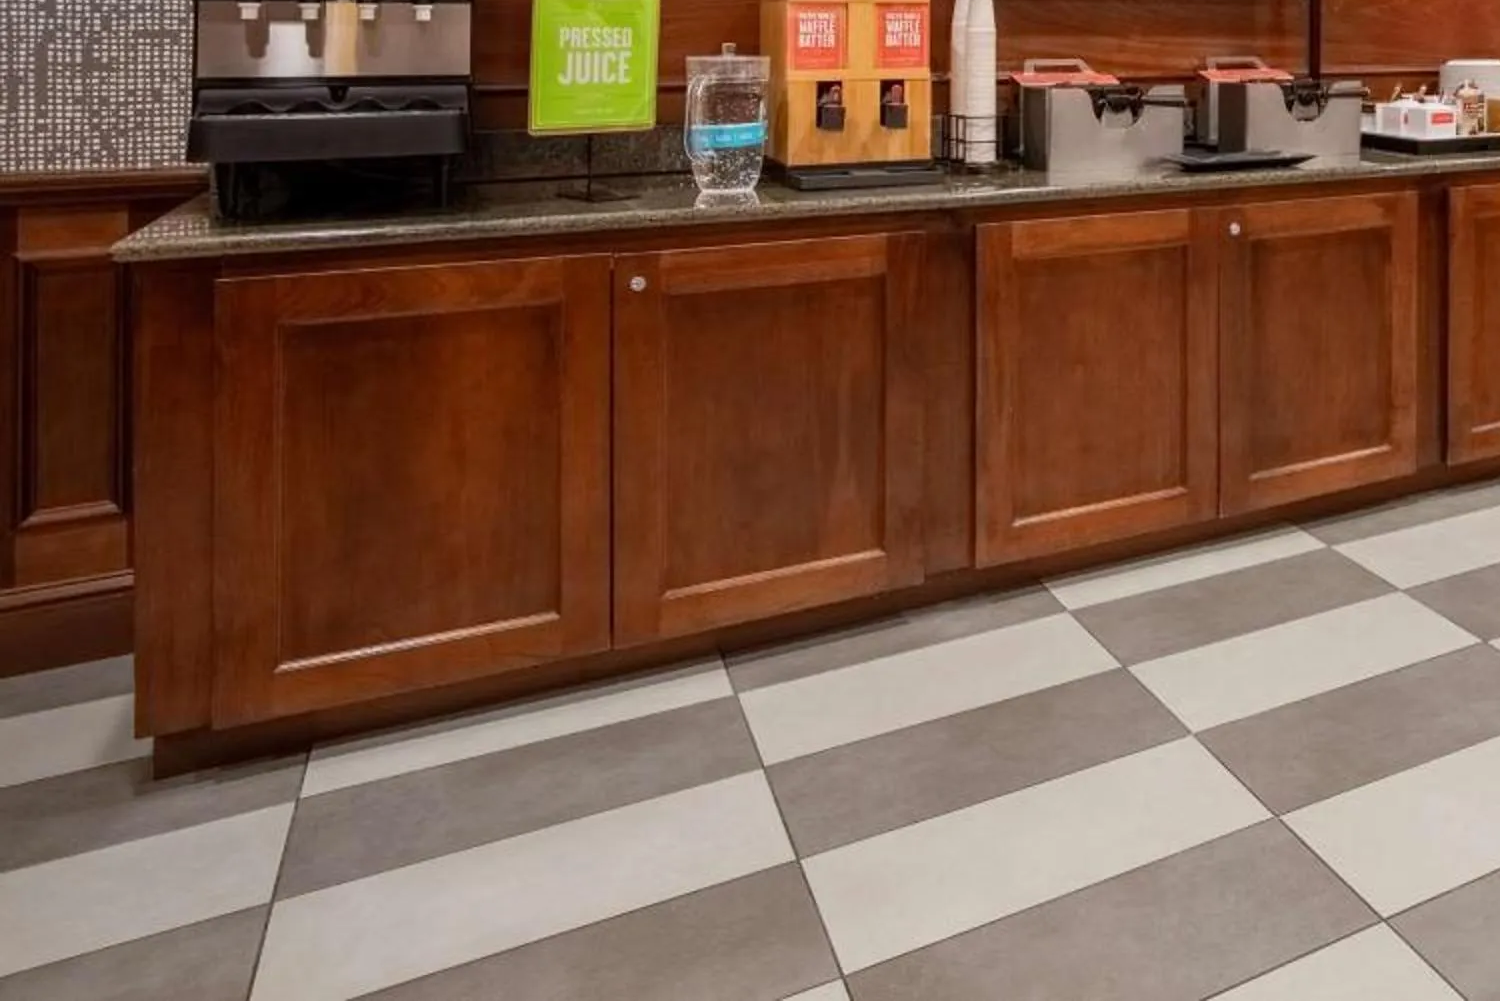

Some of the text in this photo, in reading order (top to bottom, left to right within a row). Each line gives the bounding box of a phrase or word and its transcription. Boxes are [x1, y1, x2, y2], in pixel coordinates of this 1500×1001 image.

[799, 19, 836, 33] WAFFLE
[885, 19, 921, 33] WAFFLE
[559, 26, 633, 49] PRESSED
[799, 33, 836, 48] BATTER
[557, 50, 633, 86] JUICE
